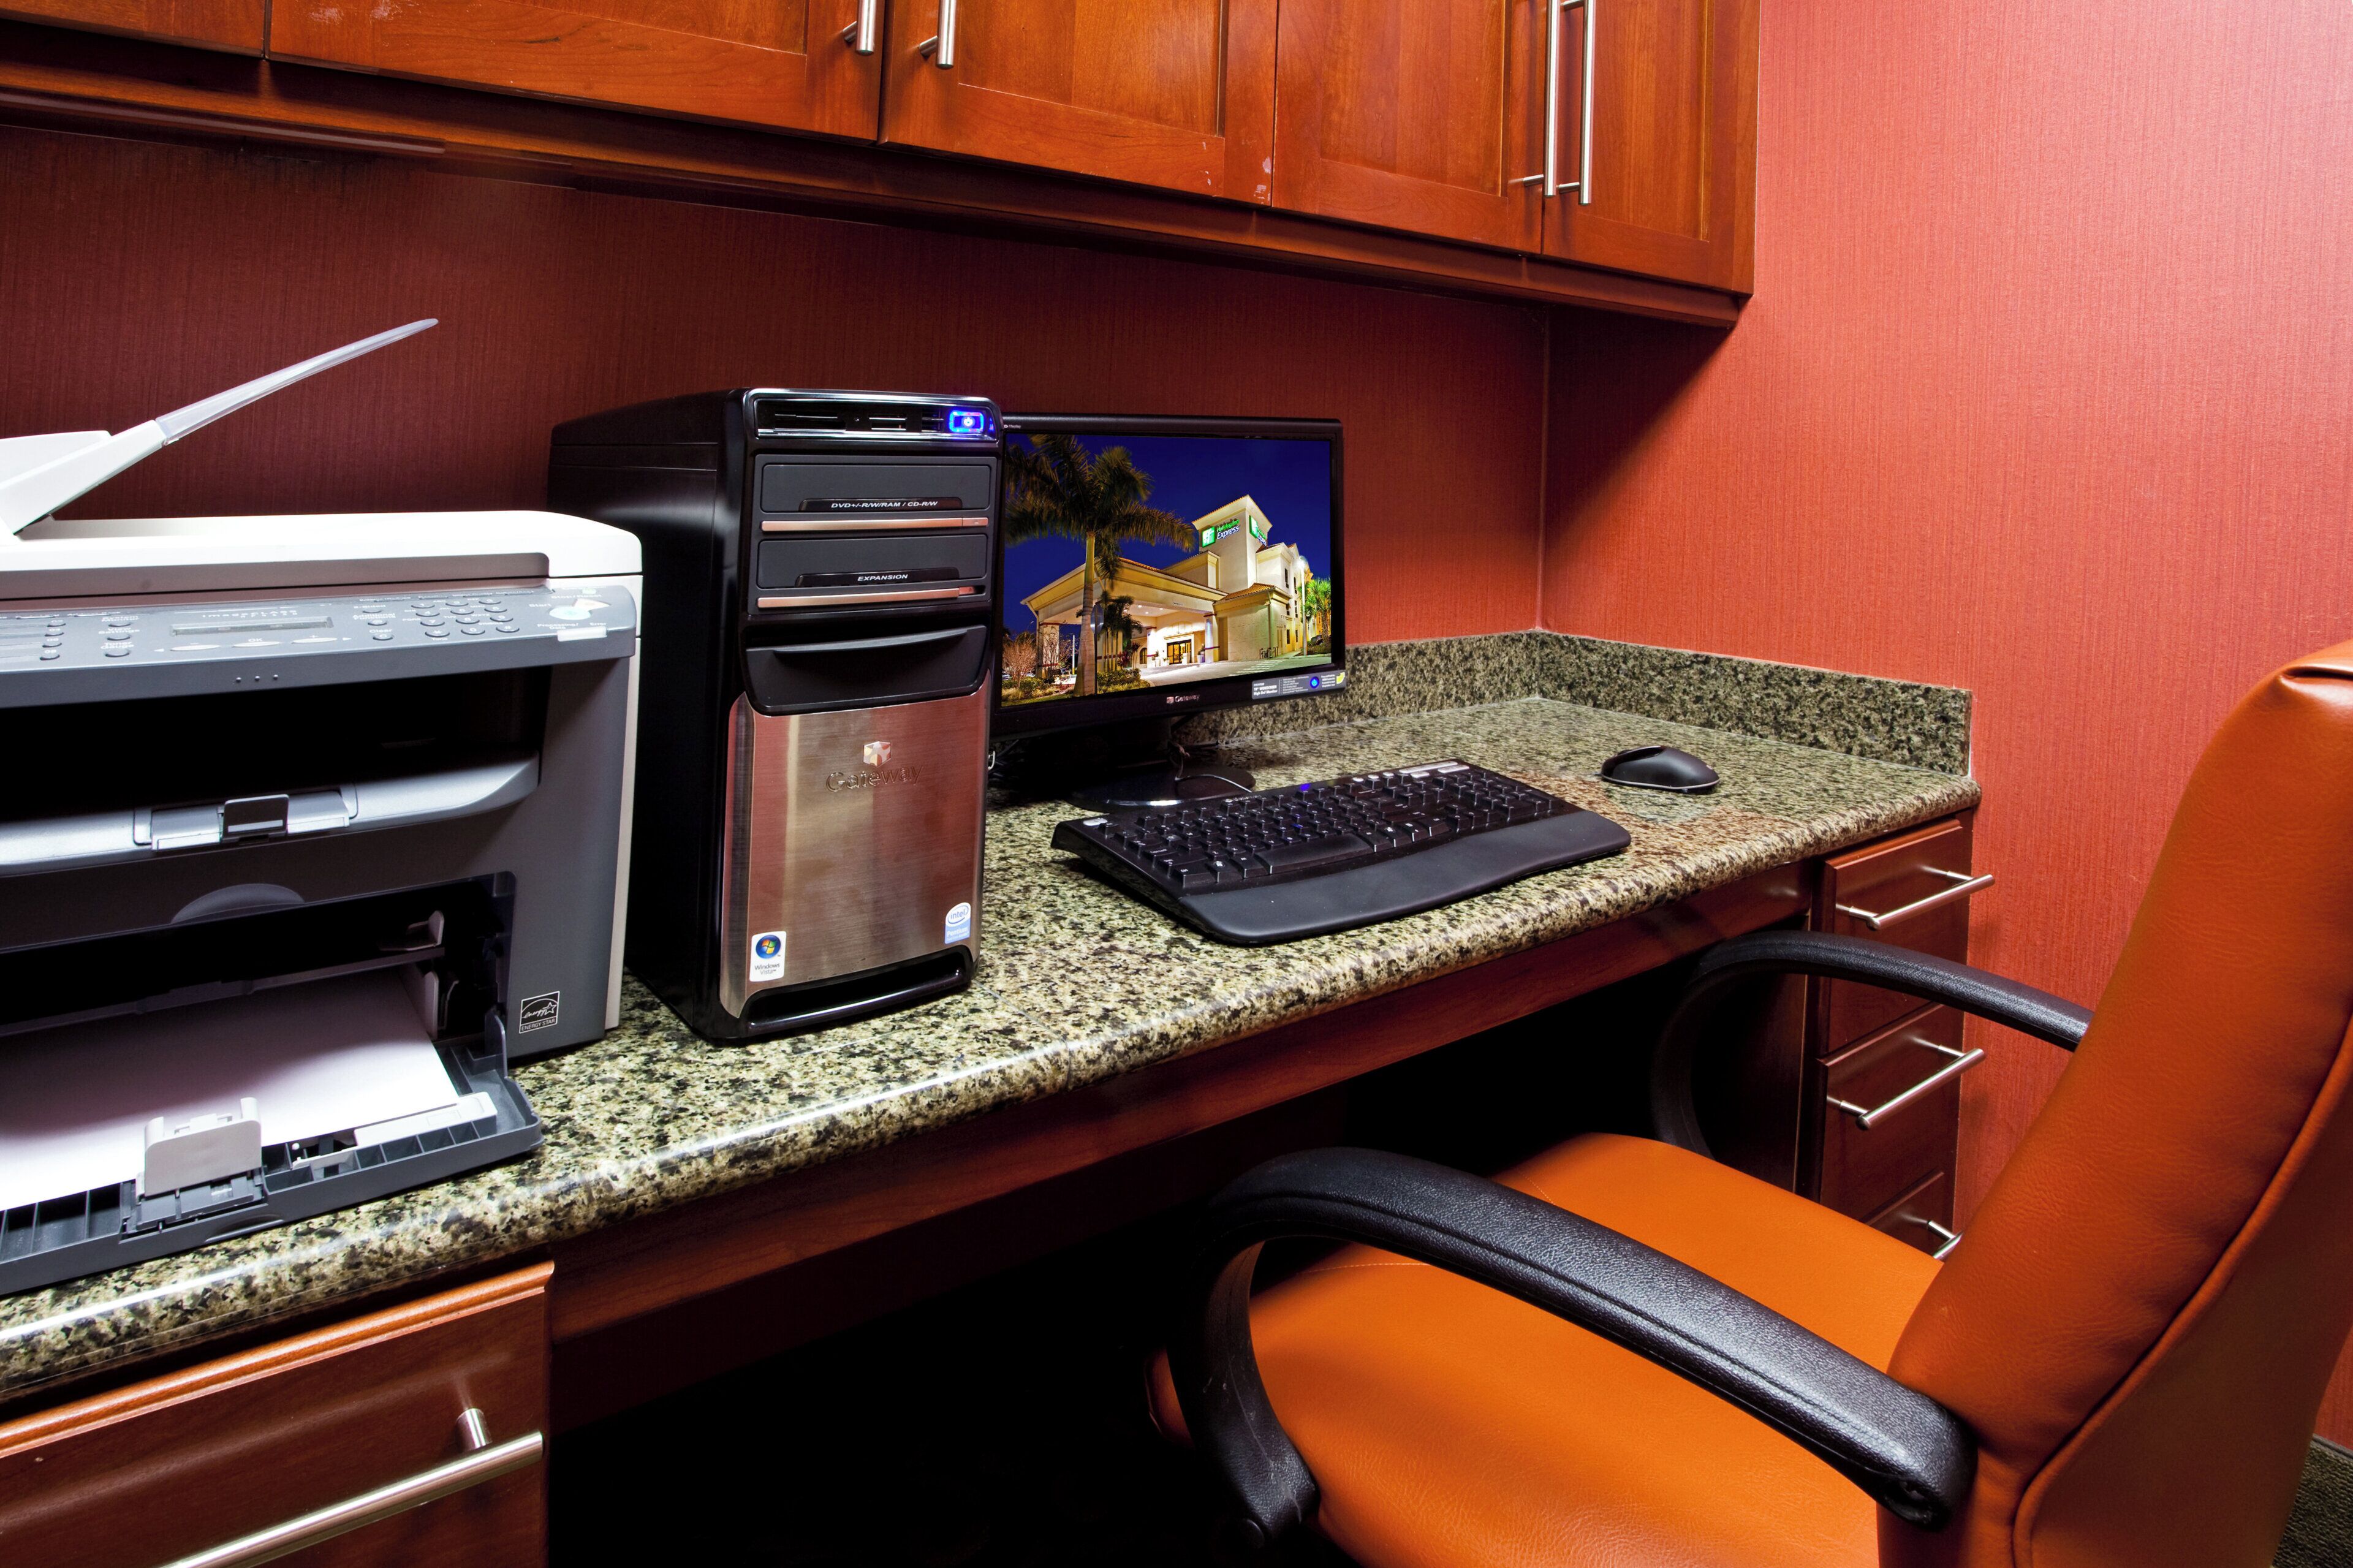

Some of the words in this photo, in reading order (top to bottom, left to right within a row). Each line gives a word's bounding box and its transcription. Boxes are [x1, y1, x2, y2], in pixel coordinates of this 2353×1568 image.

[1217, 525, 1241, 539] Express
[826, 766, 924, 792] Gateway
[950, 909, 966, 920] intel
[521, 1022, 541, 1031] ENERGY
